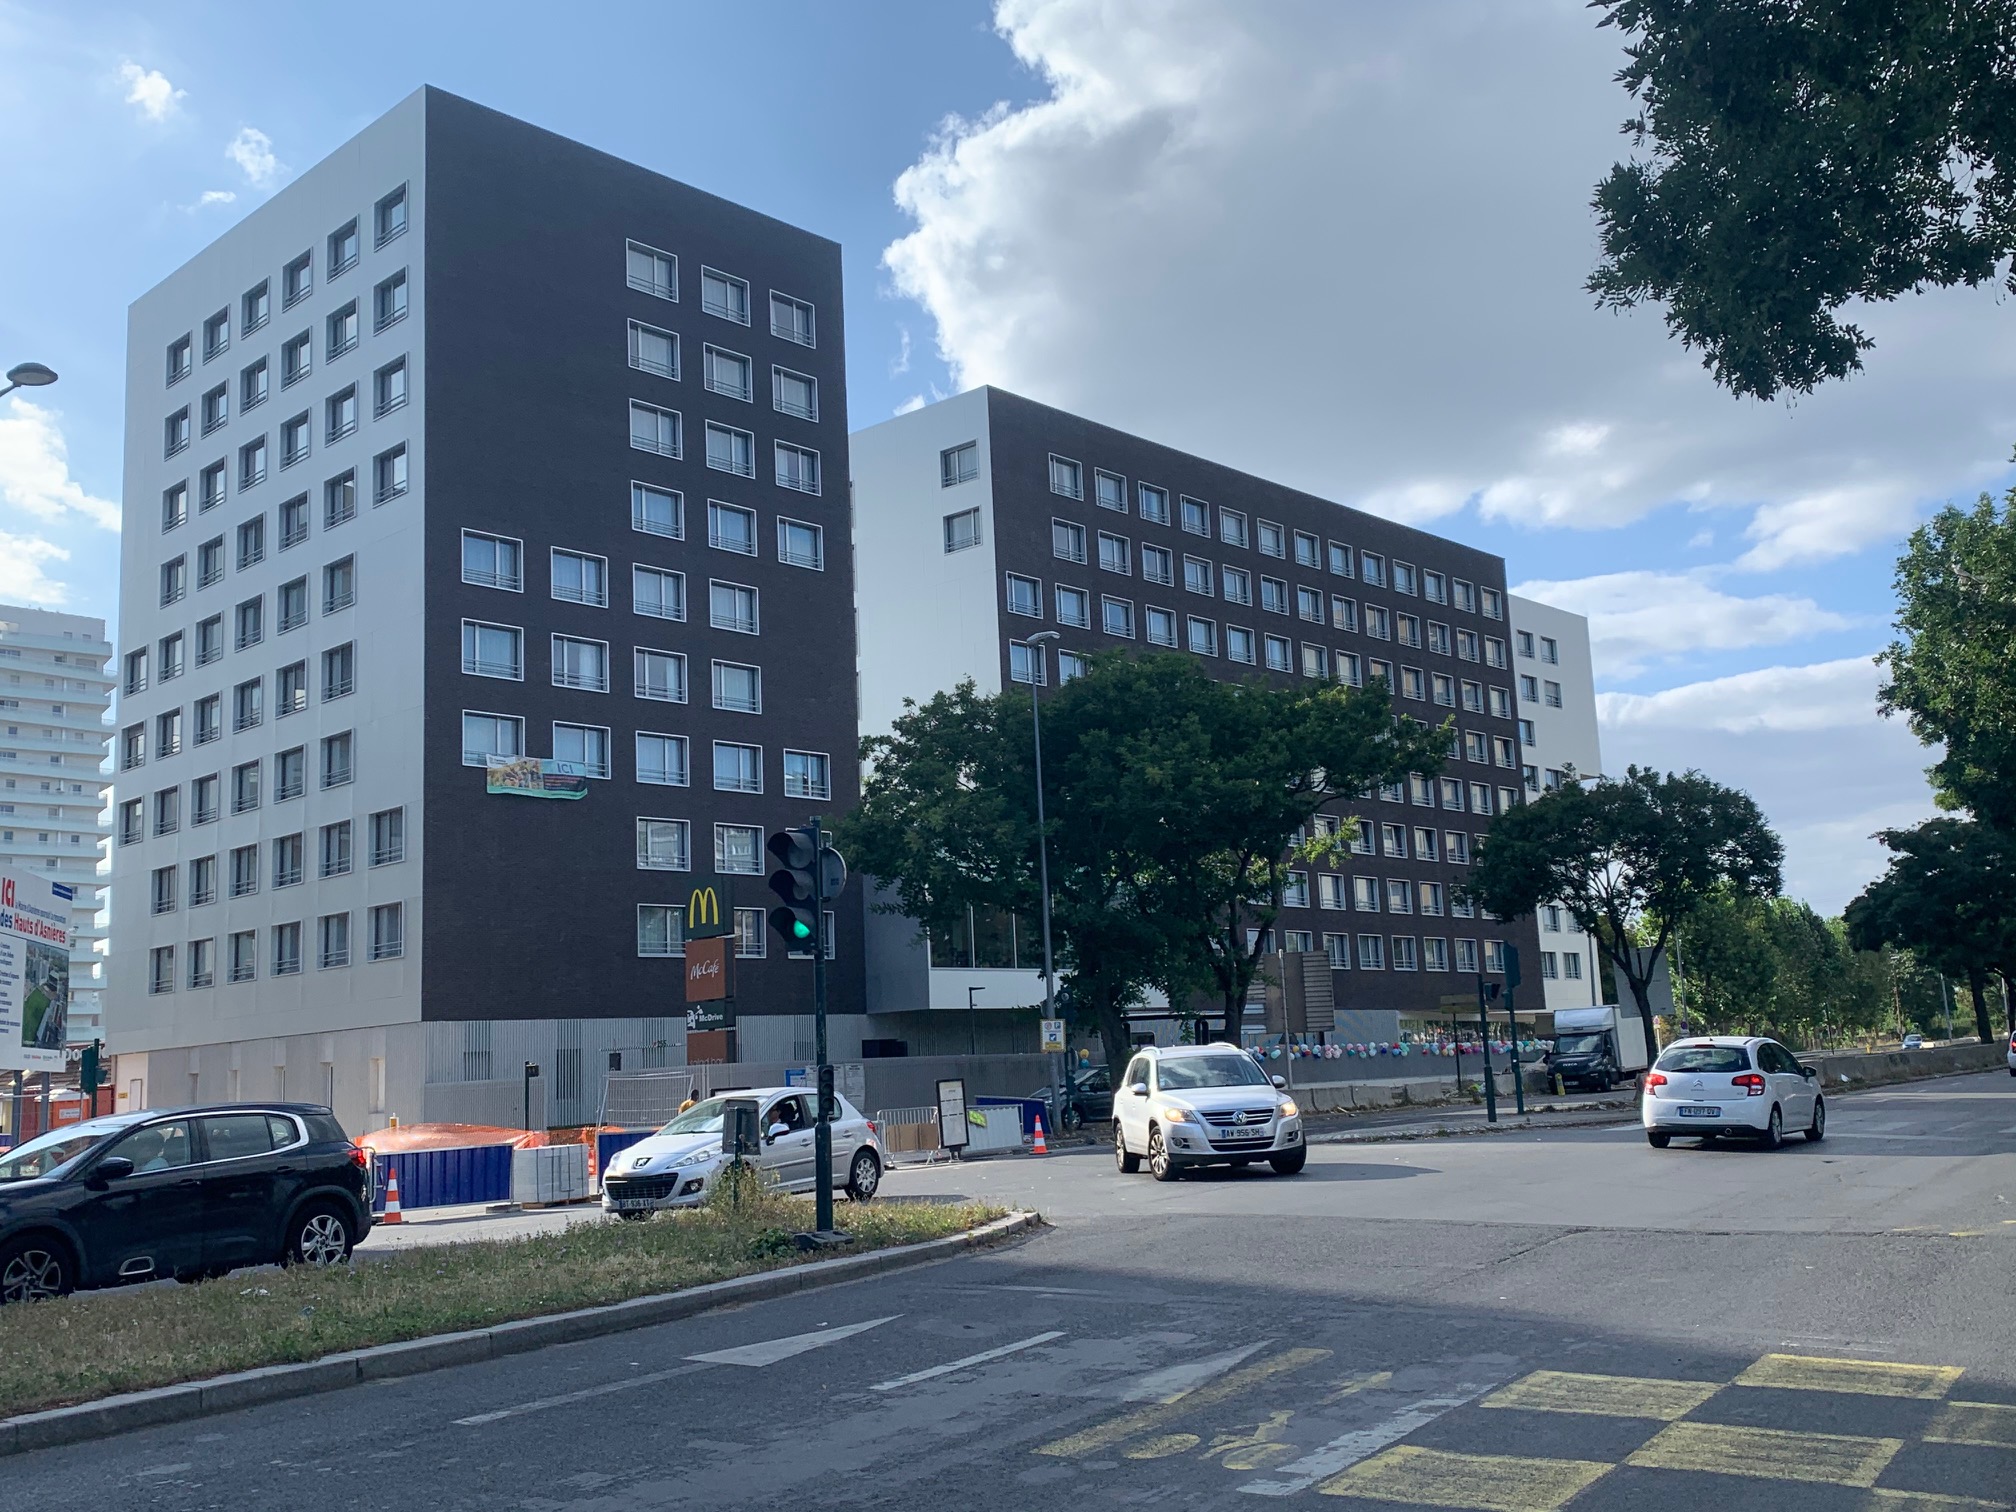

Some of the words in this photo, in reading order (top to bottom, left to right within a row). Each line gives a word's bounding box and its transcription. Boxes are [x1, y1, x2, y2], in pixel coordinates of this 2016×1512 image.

[557, 763, 574, 774] ICI
[1, 877, 16, 908] ICI
[0, 908, 13, 930] des
[14, 912, 34, 935] Hauts
[34, 918, 66, 944] d'Asnières
[690, 958, 720, 980] McCafé
[699, 1013, 724, 1022] McDrive
